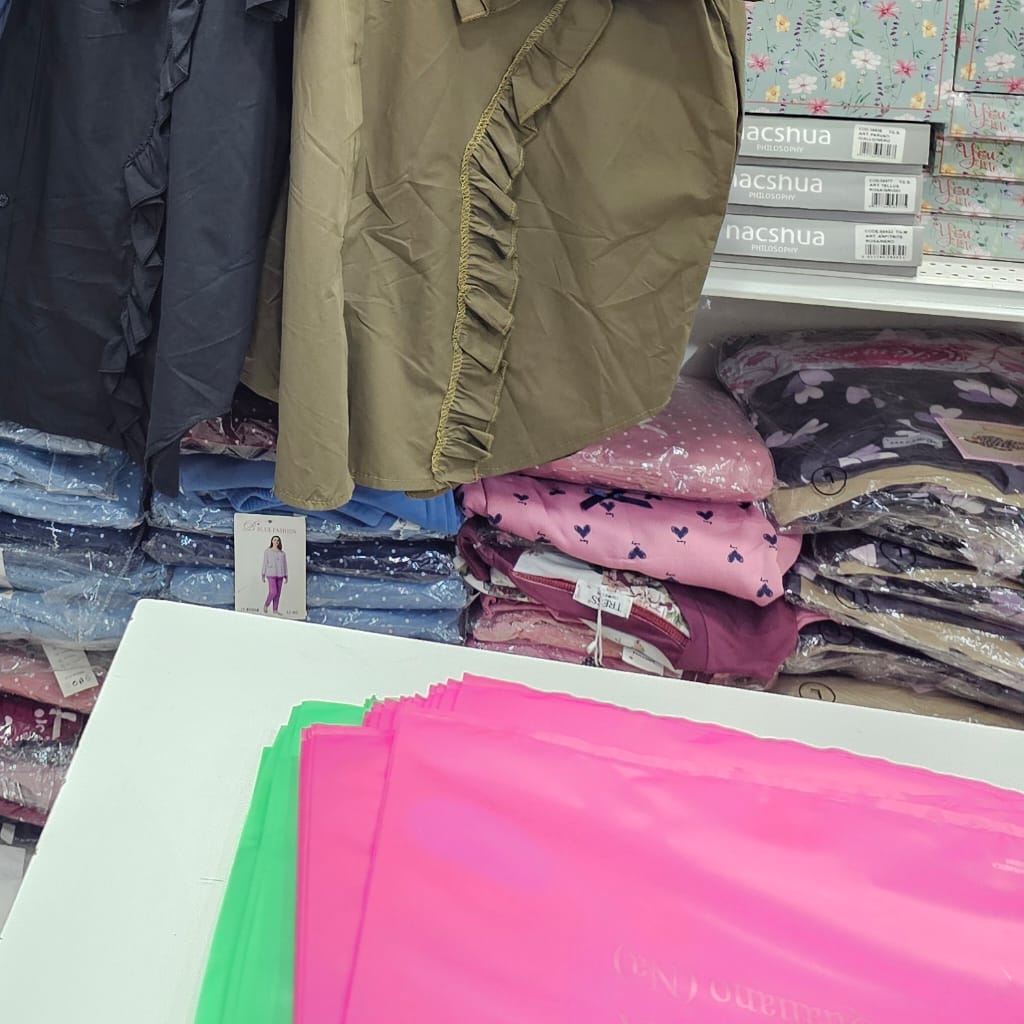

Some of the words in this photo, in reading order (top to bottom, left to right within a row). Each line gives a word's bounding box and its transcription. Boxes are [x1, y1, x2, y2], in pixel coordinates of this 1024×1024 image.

[741, 124, 831, 145] acshua
[756, 143, 805, 153] PHILOSOPHY
[748, 191, 796, 201] PHILOSOPHY
[751, 243, 799, 254] PHILOSOPHY
